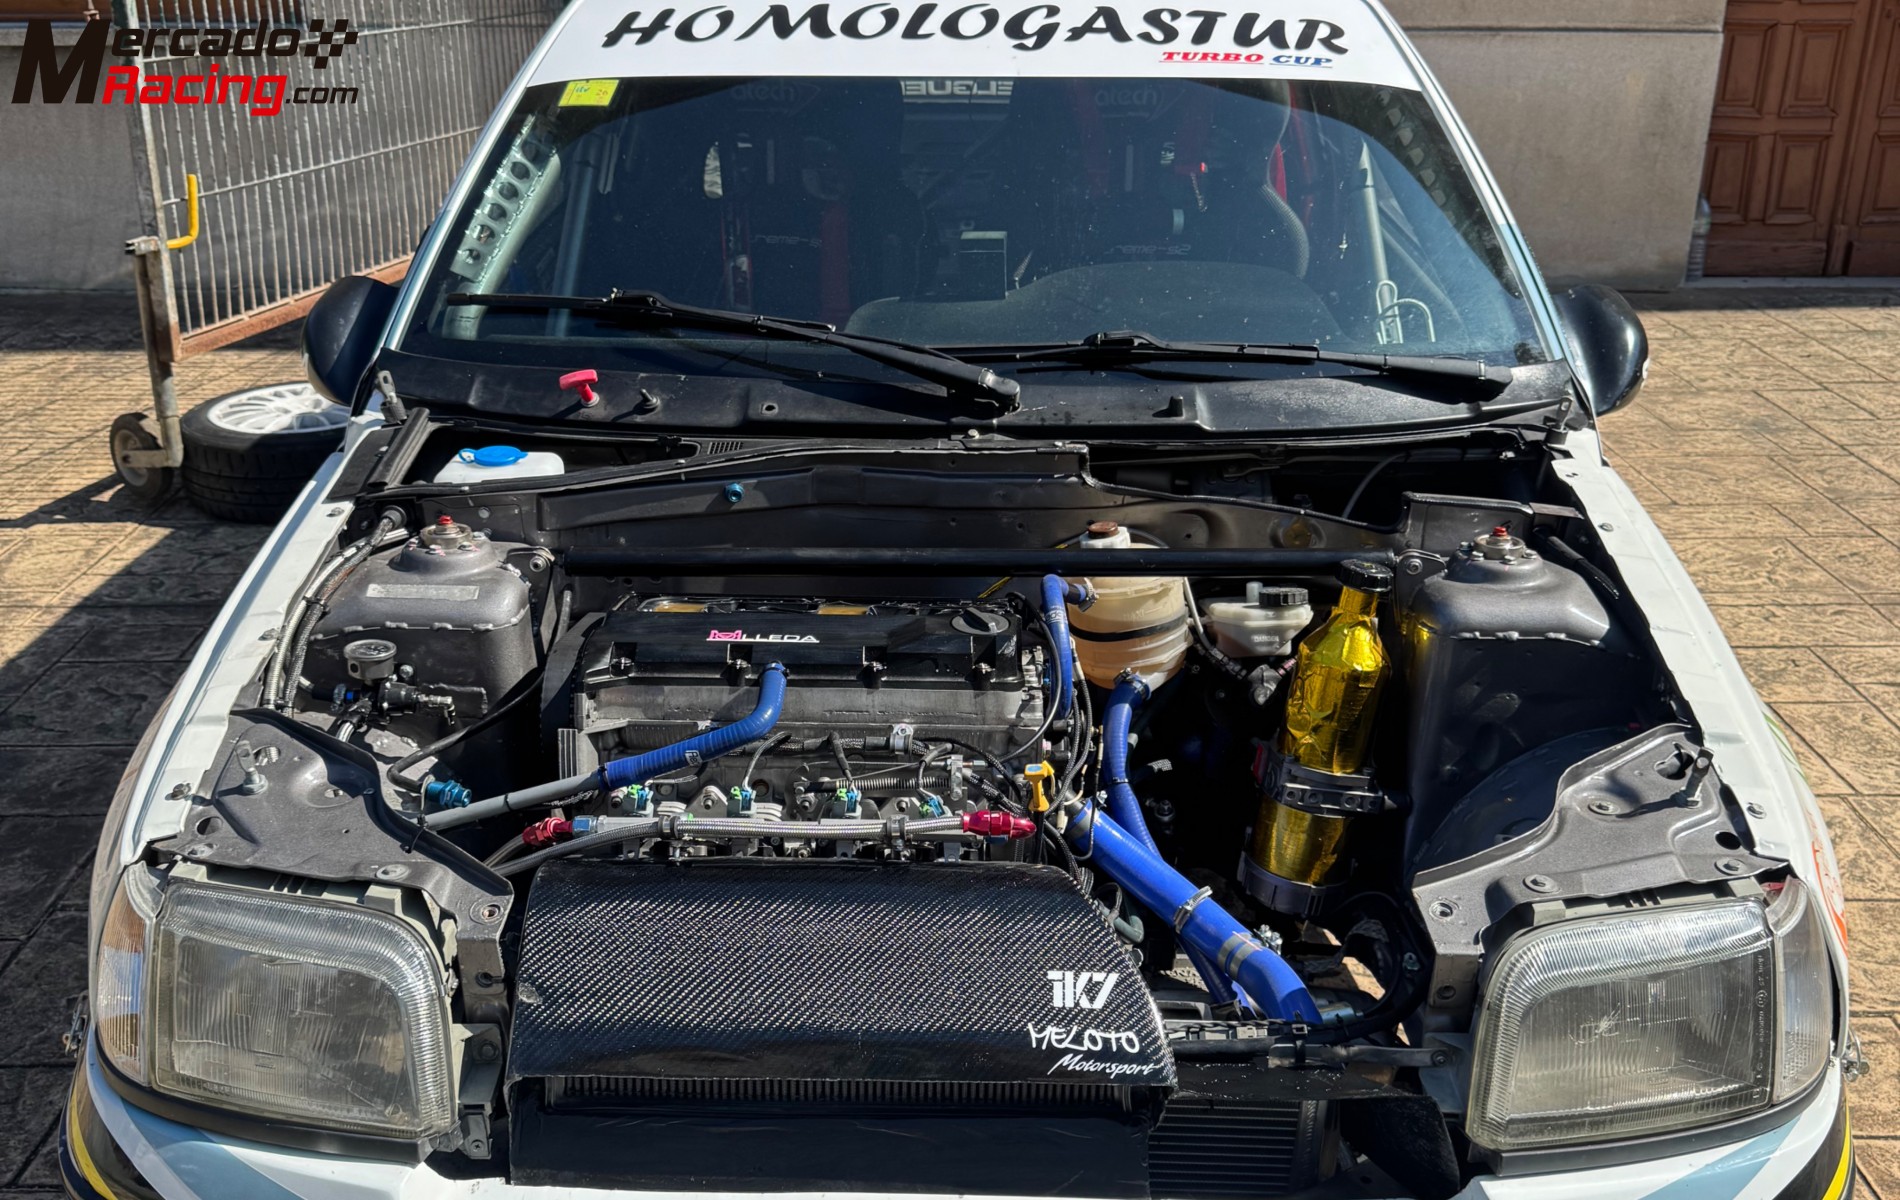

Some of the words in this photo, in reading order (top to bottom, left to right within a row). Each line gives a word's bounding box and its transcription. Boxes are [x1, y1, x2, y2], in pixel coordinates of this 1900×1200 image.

[601, 3, 1349, 54] HOMOLOGASTUR
[1162, 51, 1265, 63] TURBO
[1271, 54, 1333, 66] CUP
[1047, 1053, 1160, 1079] Motorsport
